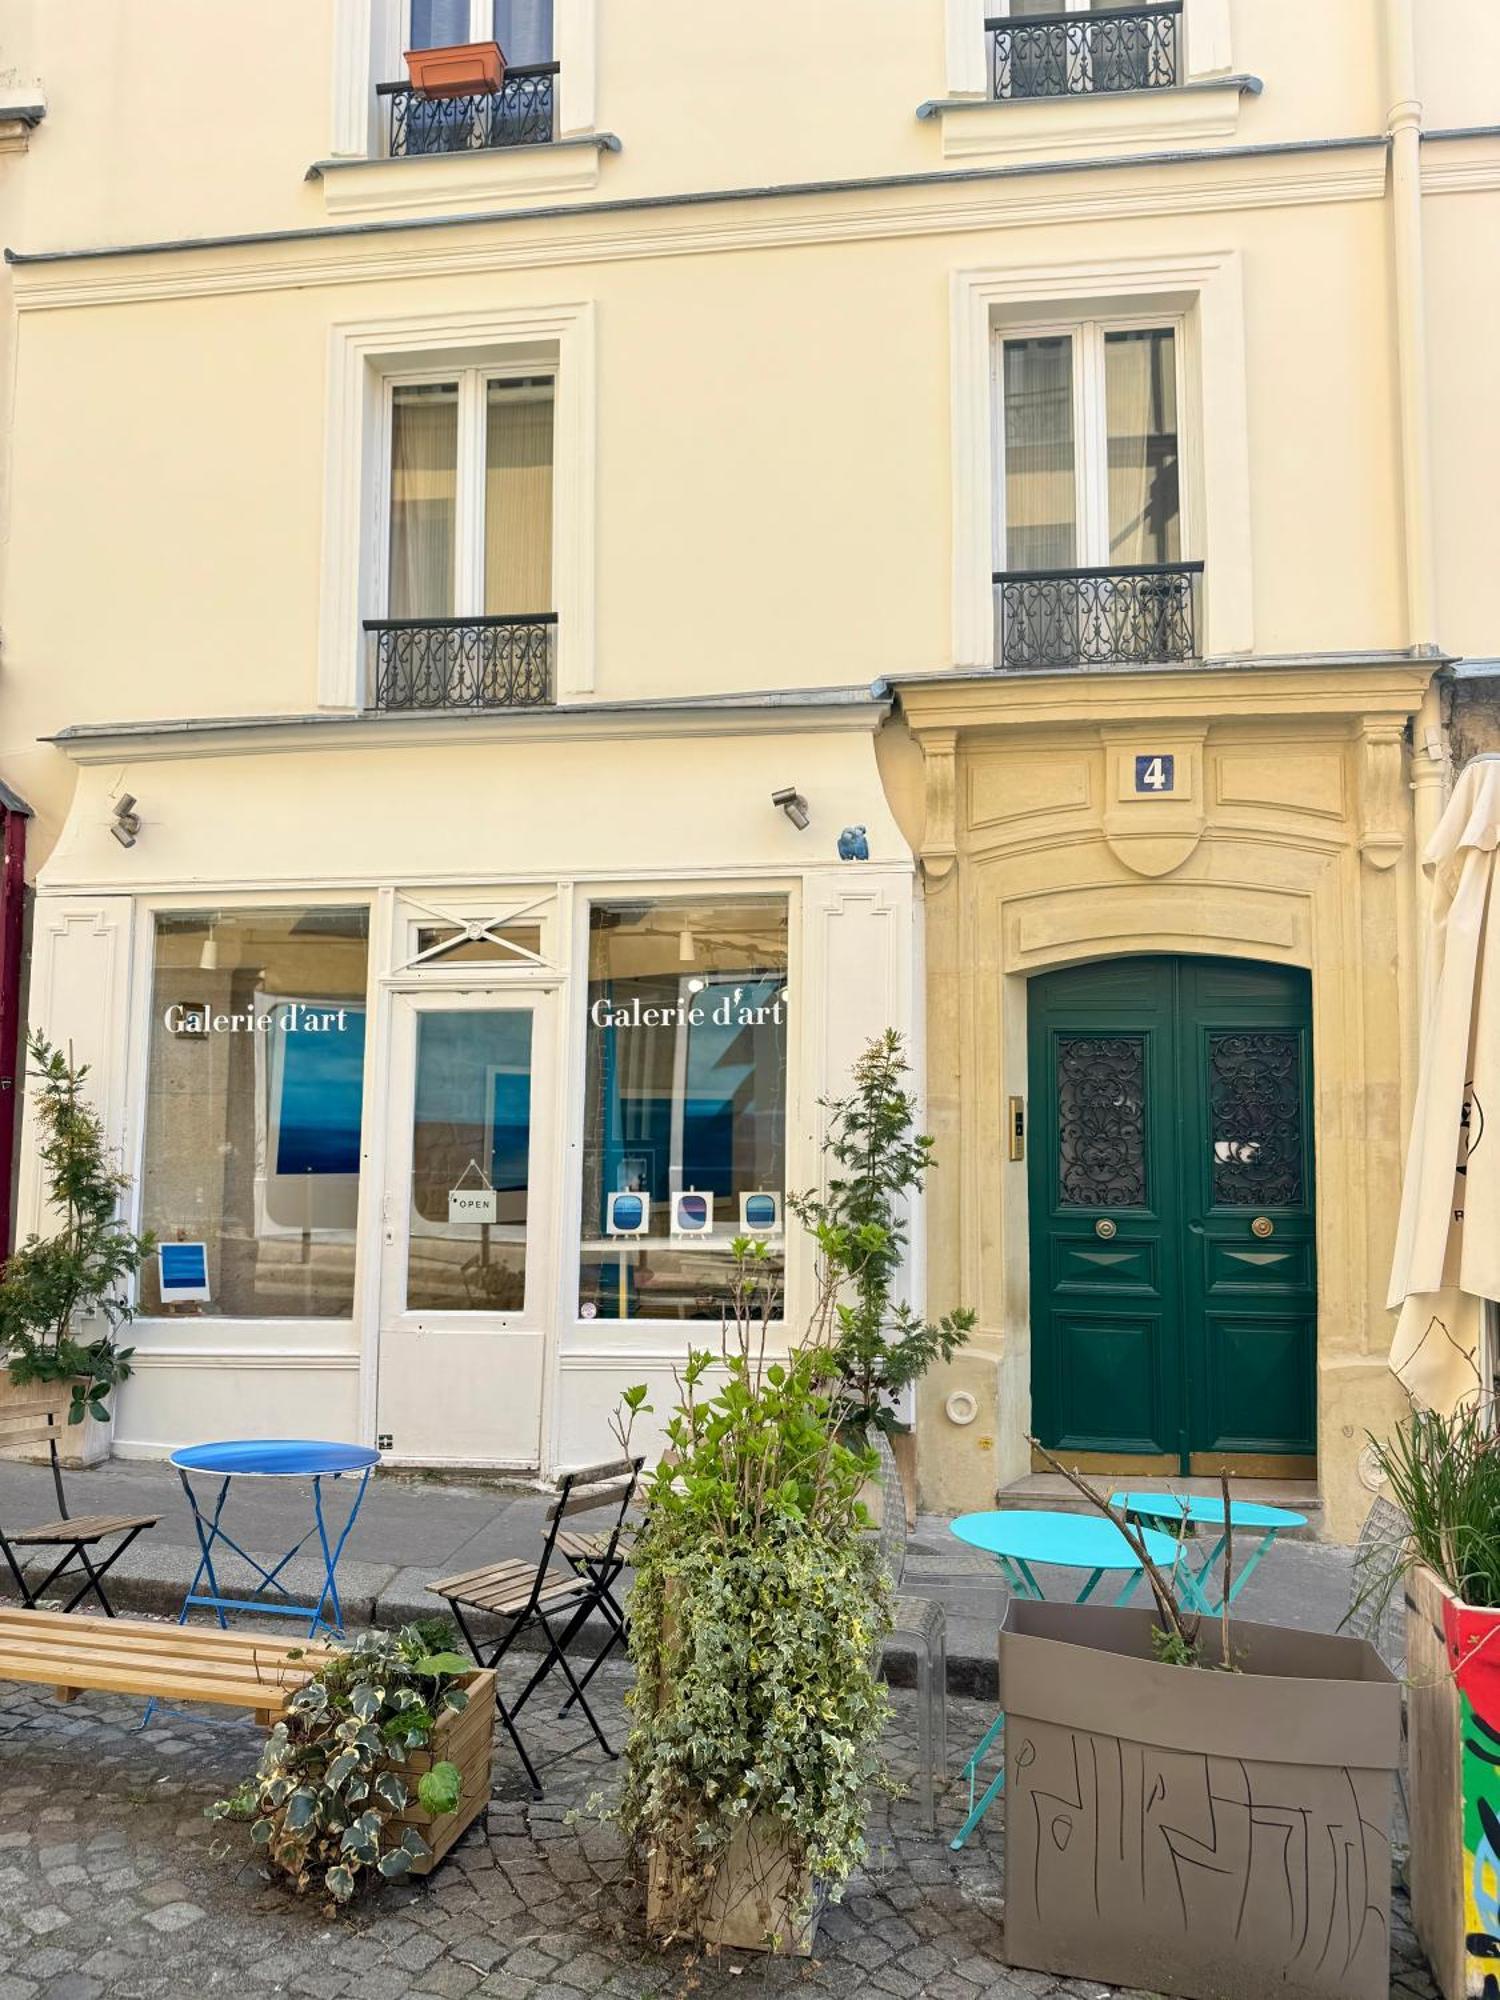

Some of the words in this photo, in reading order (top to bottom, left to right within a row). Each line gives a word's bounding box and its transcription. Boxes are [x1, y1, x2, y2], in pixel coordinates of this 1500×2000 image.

[1143, 758, 1166, 790] 4
[164, 1004, 272, 1033] Galerie
[280, 1003, 347, 1032] d'art
[591, 998, 705, 1027] Galerie
[712, 995, 784, 1025] d'art
[459, 1200, 490, 1209] OPEN
